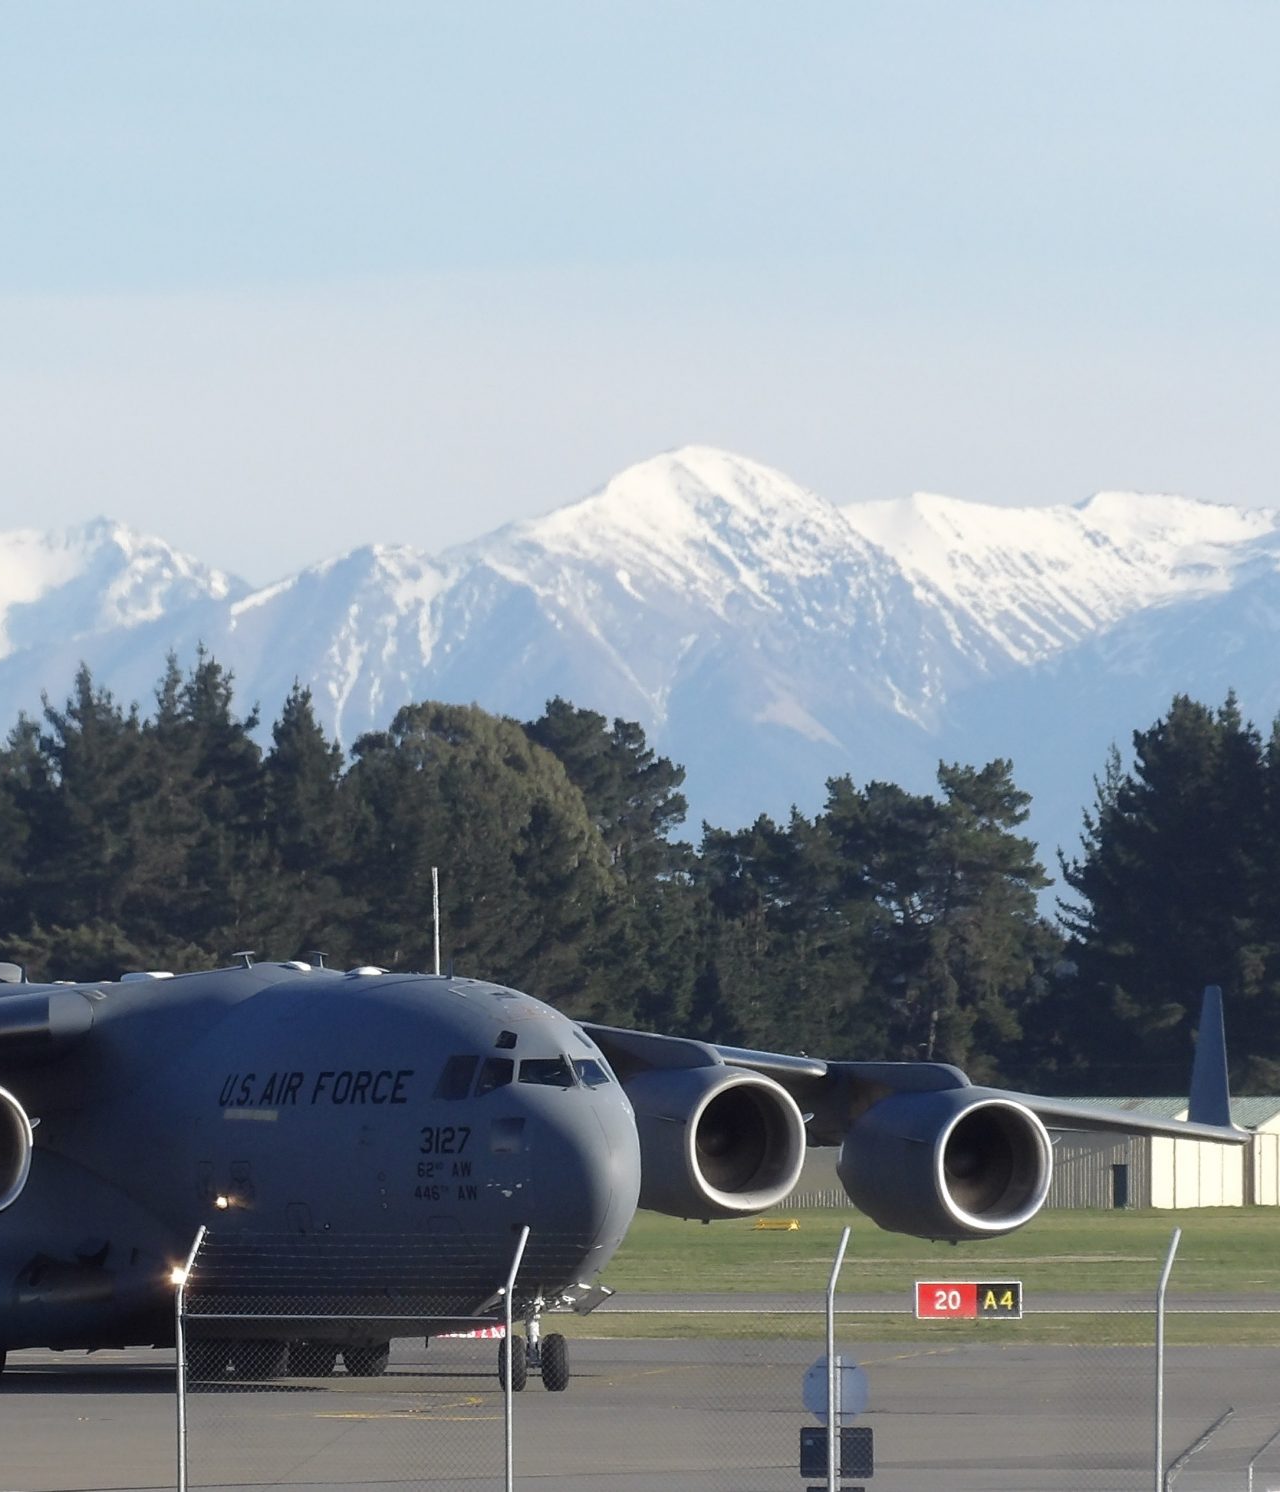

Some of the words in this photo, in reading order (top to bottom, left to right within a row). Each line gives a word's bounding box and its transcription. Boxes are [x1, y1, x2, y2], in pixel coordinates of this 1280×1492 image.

[311, 1069, 415, 1105] FORCE
[420, 1126, 472, 1154] 3127
[452, 1161, 472, 1177] AW
[458, 1184, 477, 1201] AW
[934, 1290, 961, 1310] 20
[983, 1290, 1014, 1310] A4
